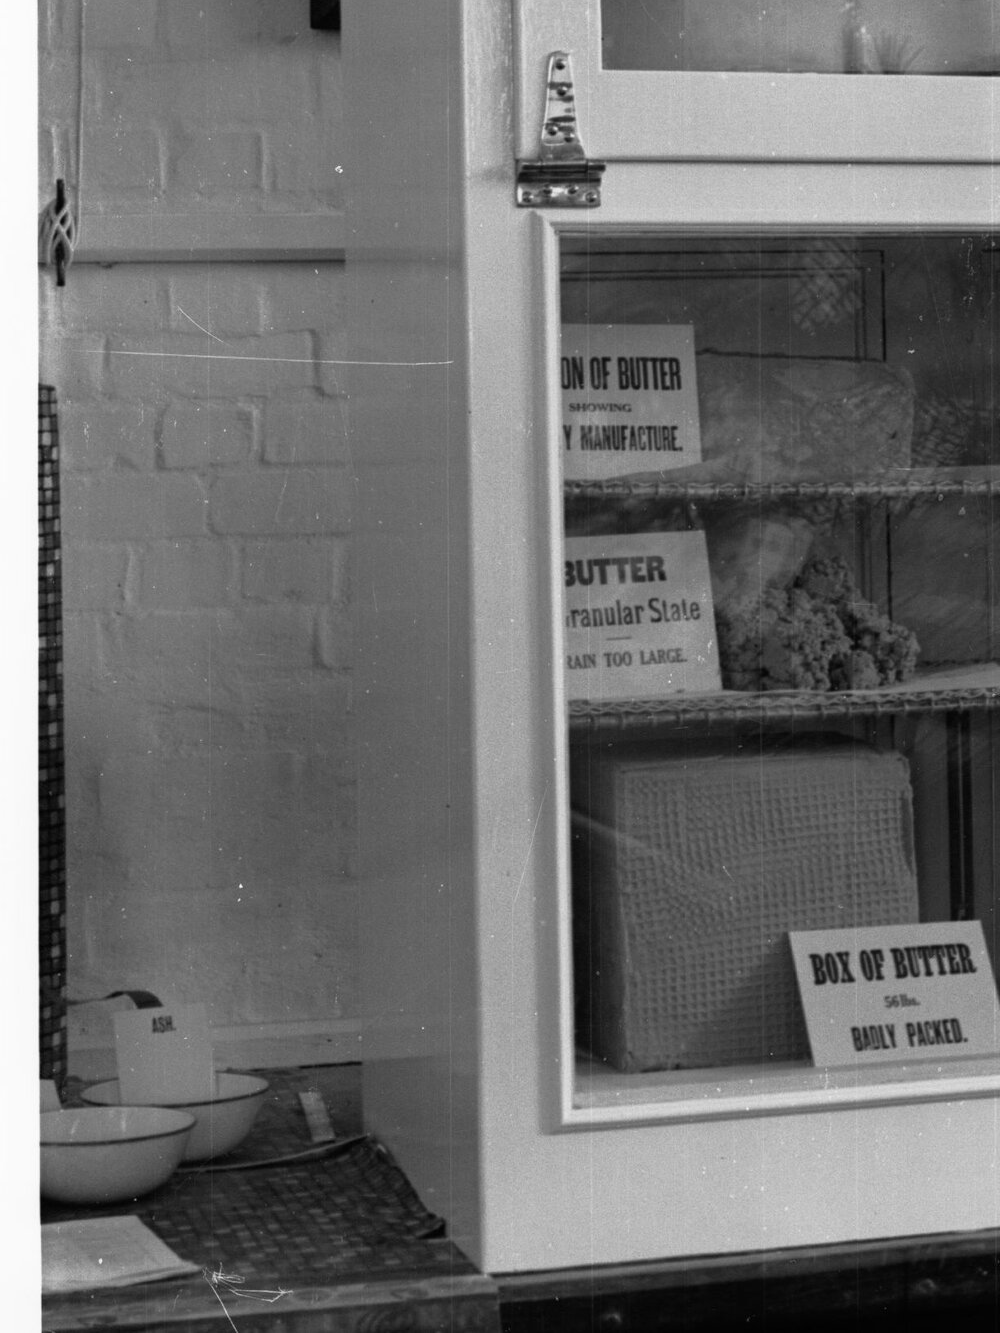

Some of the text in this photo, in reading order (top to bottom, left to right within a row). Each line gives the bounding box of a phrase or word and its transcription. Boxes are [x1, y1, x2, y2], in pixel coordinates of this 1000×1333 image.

[590, 356, 611, 390] OF
[618, 356, 682, 391] BUTTER
[568, 402, 632, 412] SHOWING
[580, 425, 683, 451] MANUFACTURE.
[566, 597, 701, 628] ranular State
[604, 651, 632, 667] TOO
[640, 648, 688, 665] LARGE.
[809, 943, 977, 985] BOX OF BUTTER
[851, 1018, 968, 1052] BADLY PACKED.
